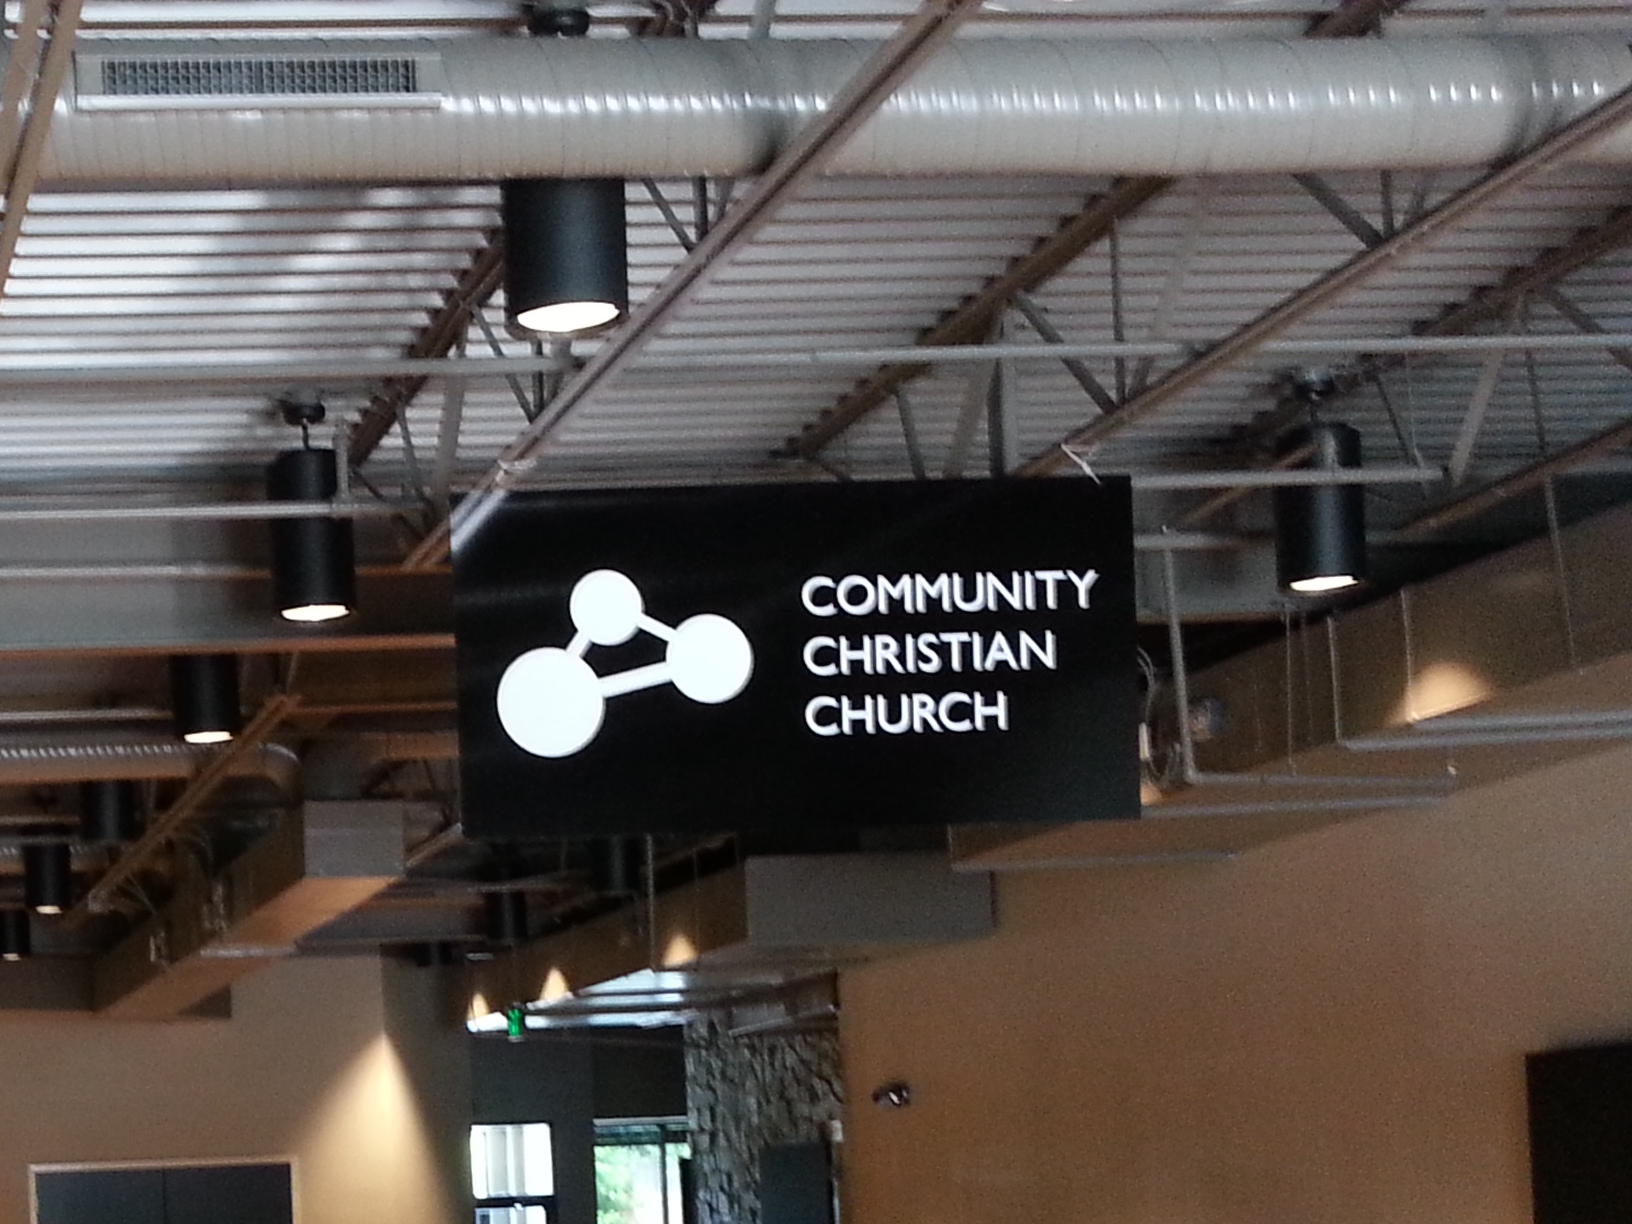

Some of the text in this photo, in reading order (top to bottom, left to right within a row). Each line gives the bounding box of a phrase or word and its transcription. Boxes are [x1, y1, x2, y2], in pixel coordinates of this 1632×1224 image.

[800, 568, 1099, 617] COMMUNITY
[802, 629, 1058, 676] CHRISTIAN
[804, 690, 1009, 736] CHURCH
